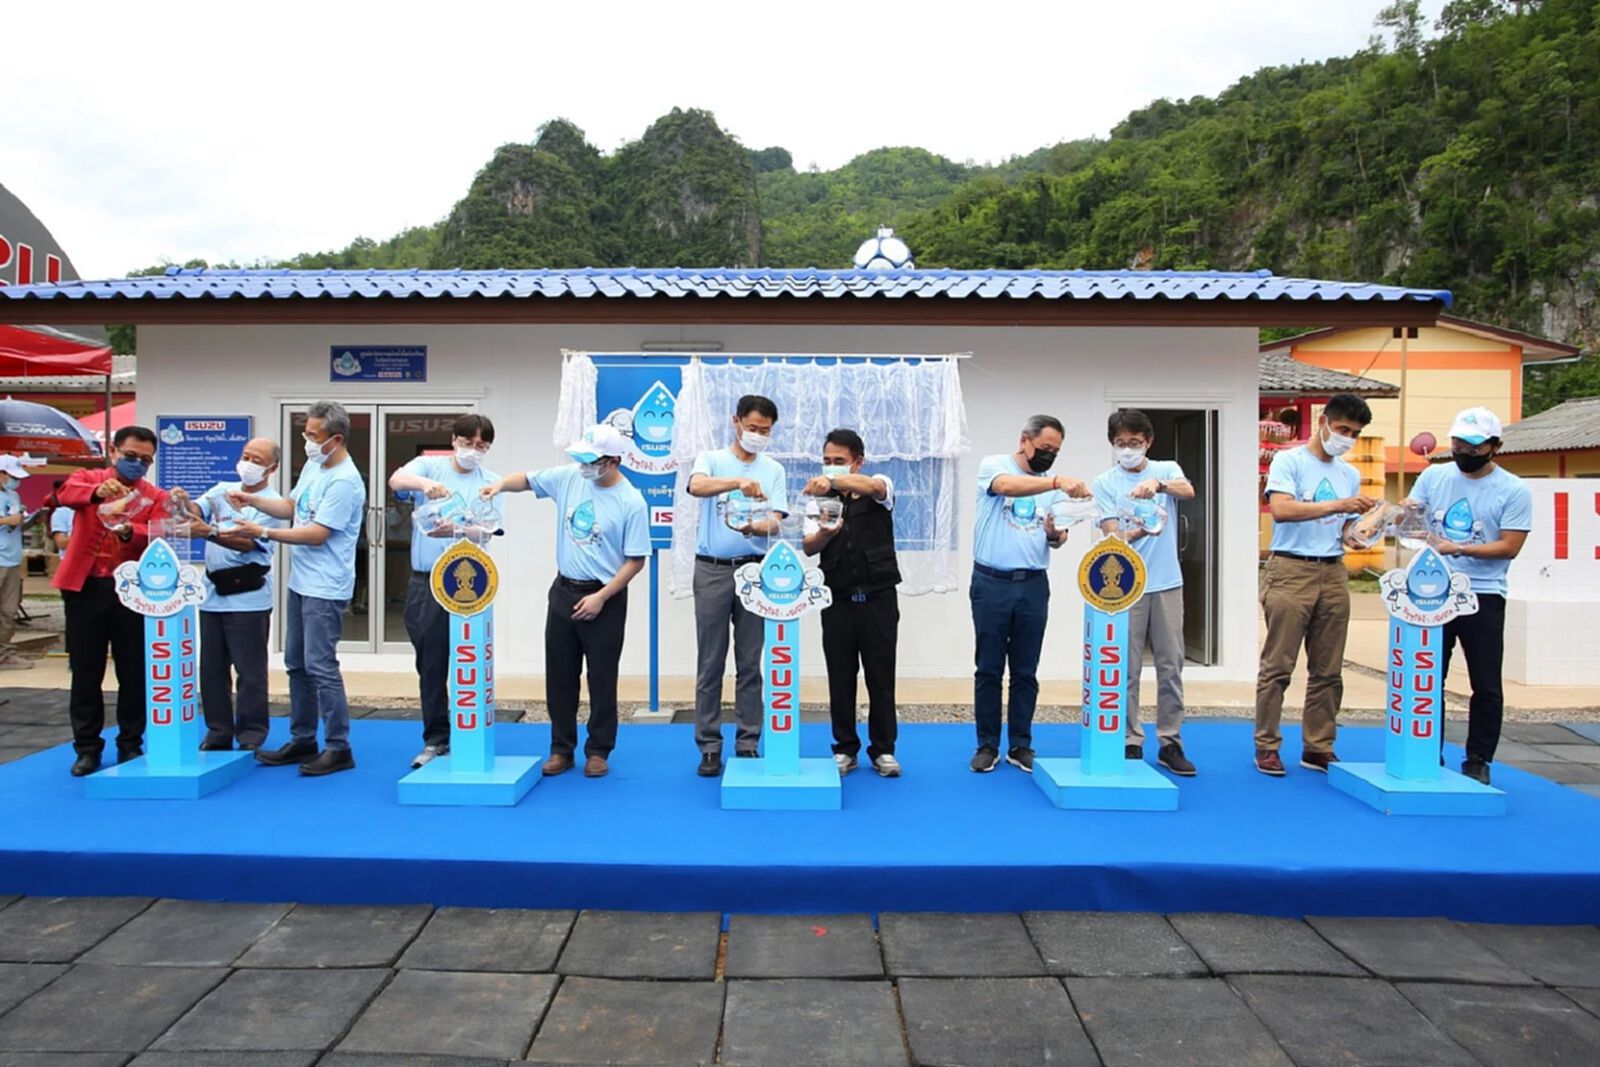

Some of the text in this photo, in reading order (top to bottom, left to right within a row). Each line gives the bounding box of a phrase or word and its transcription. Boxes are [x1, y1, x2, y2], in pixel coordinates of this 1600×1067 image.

[655, 512, 674, 523] IS
[151, 619, 172, 725] ISUZU
[181, 618, 194, 722] ISUZU
[456, 622, 477, 730] ISUZU
[771, 623, 792, 732] ISUZU
[1099, 623, 1120, 732] ISUZU
[1391, 626, 1404, 734] ISUZU
[1412, 628, 1434, 738] ISUZU
